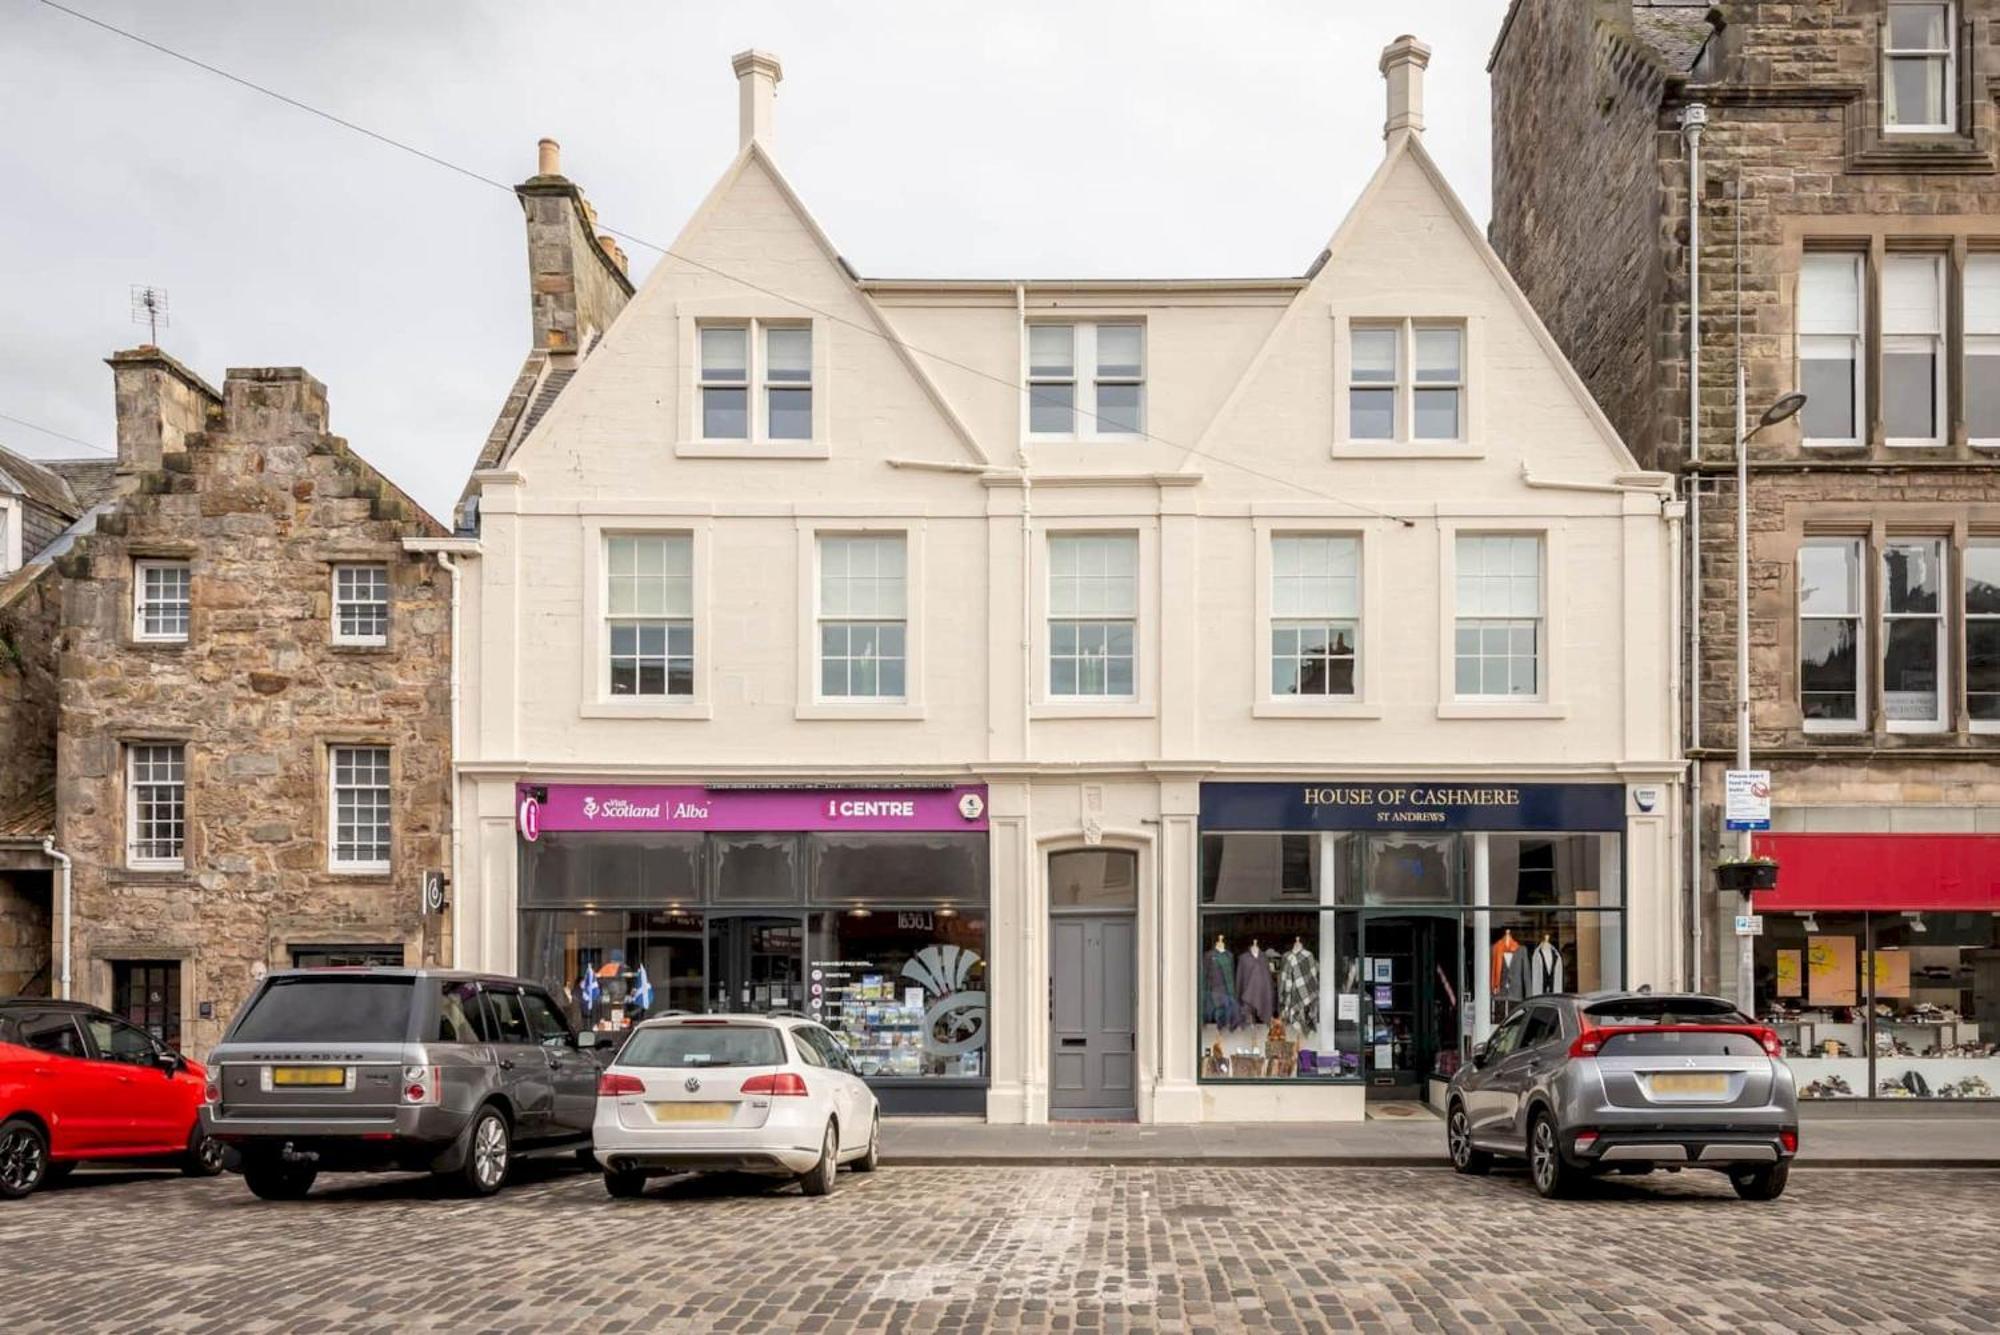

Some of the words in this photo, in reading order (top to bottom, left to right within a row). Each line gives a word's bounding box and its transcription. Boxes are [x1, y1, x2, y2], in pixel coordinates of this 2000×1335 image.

[1304, 788, 1373, 805] HOUSE
[1378, 788, 1406, 805] OF
[1410, 788, 1520, 805] CASHMERE
[601, 801, 660, 817] Scotland
[673, 802, 708, 818] Alba
[840, 801, 914, 816] CENTRE
[1377, 811, 1390, 822] ST
[1391, 811, 1446, 822] ANDREWS
